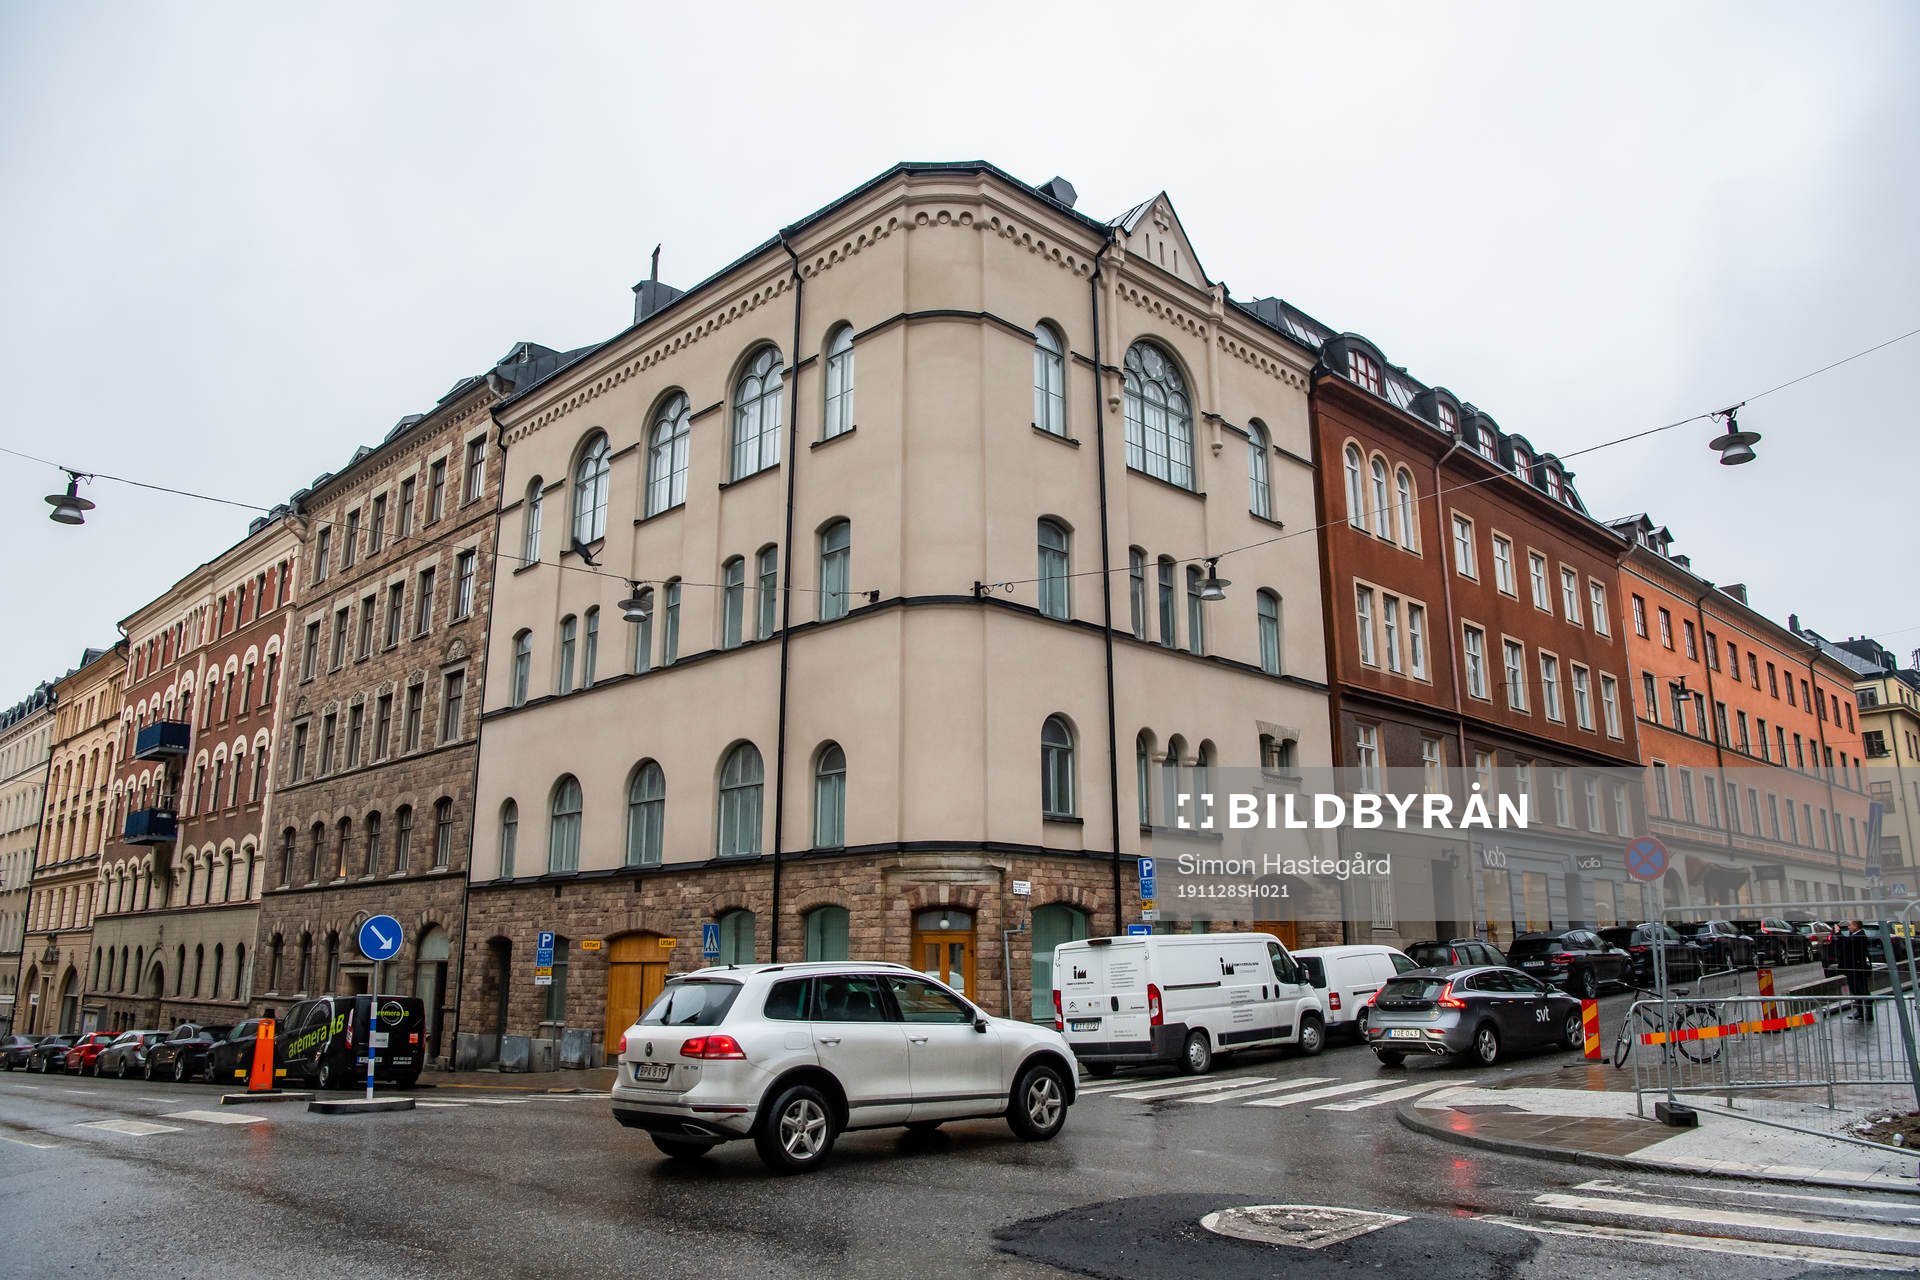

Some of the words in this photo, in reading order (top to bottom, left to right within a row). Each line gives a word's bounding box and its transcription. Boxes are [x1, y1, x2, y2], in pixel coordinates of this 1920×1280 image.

[1142, 860, 1153, 876] P
[542, 933, 552, 948] P
[1536, 1005, 1551, 1022] svt
[288, 1024, 327, 1058] aremera
[329, 1013, 345, 1036] AB
